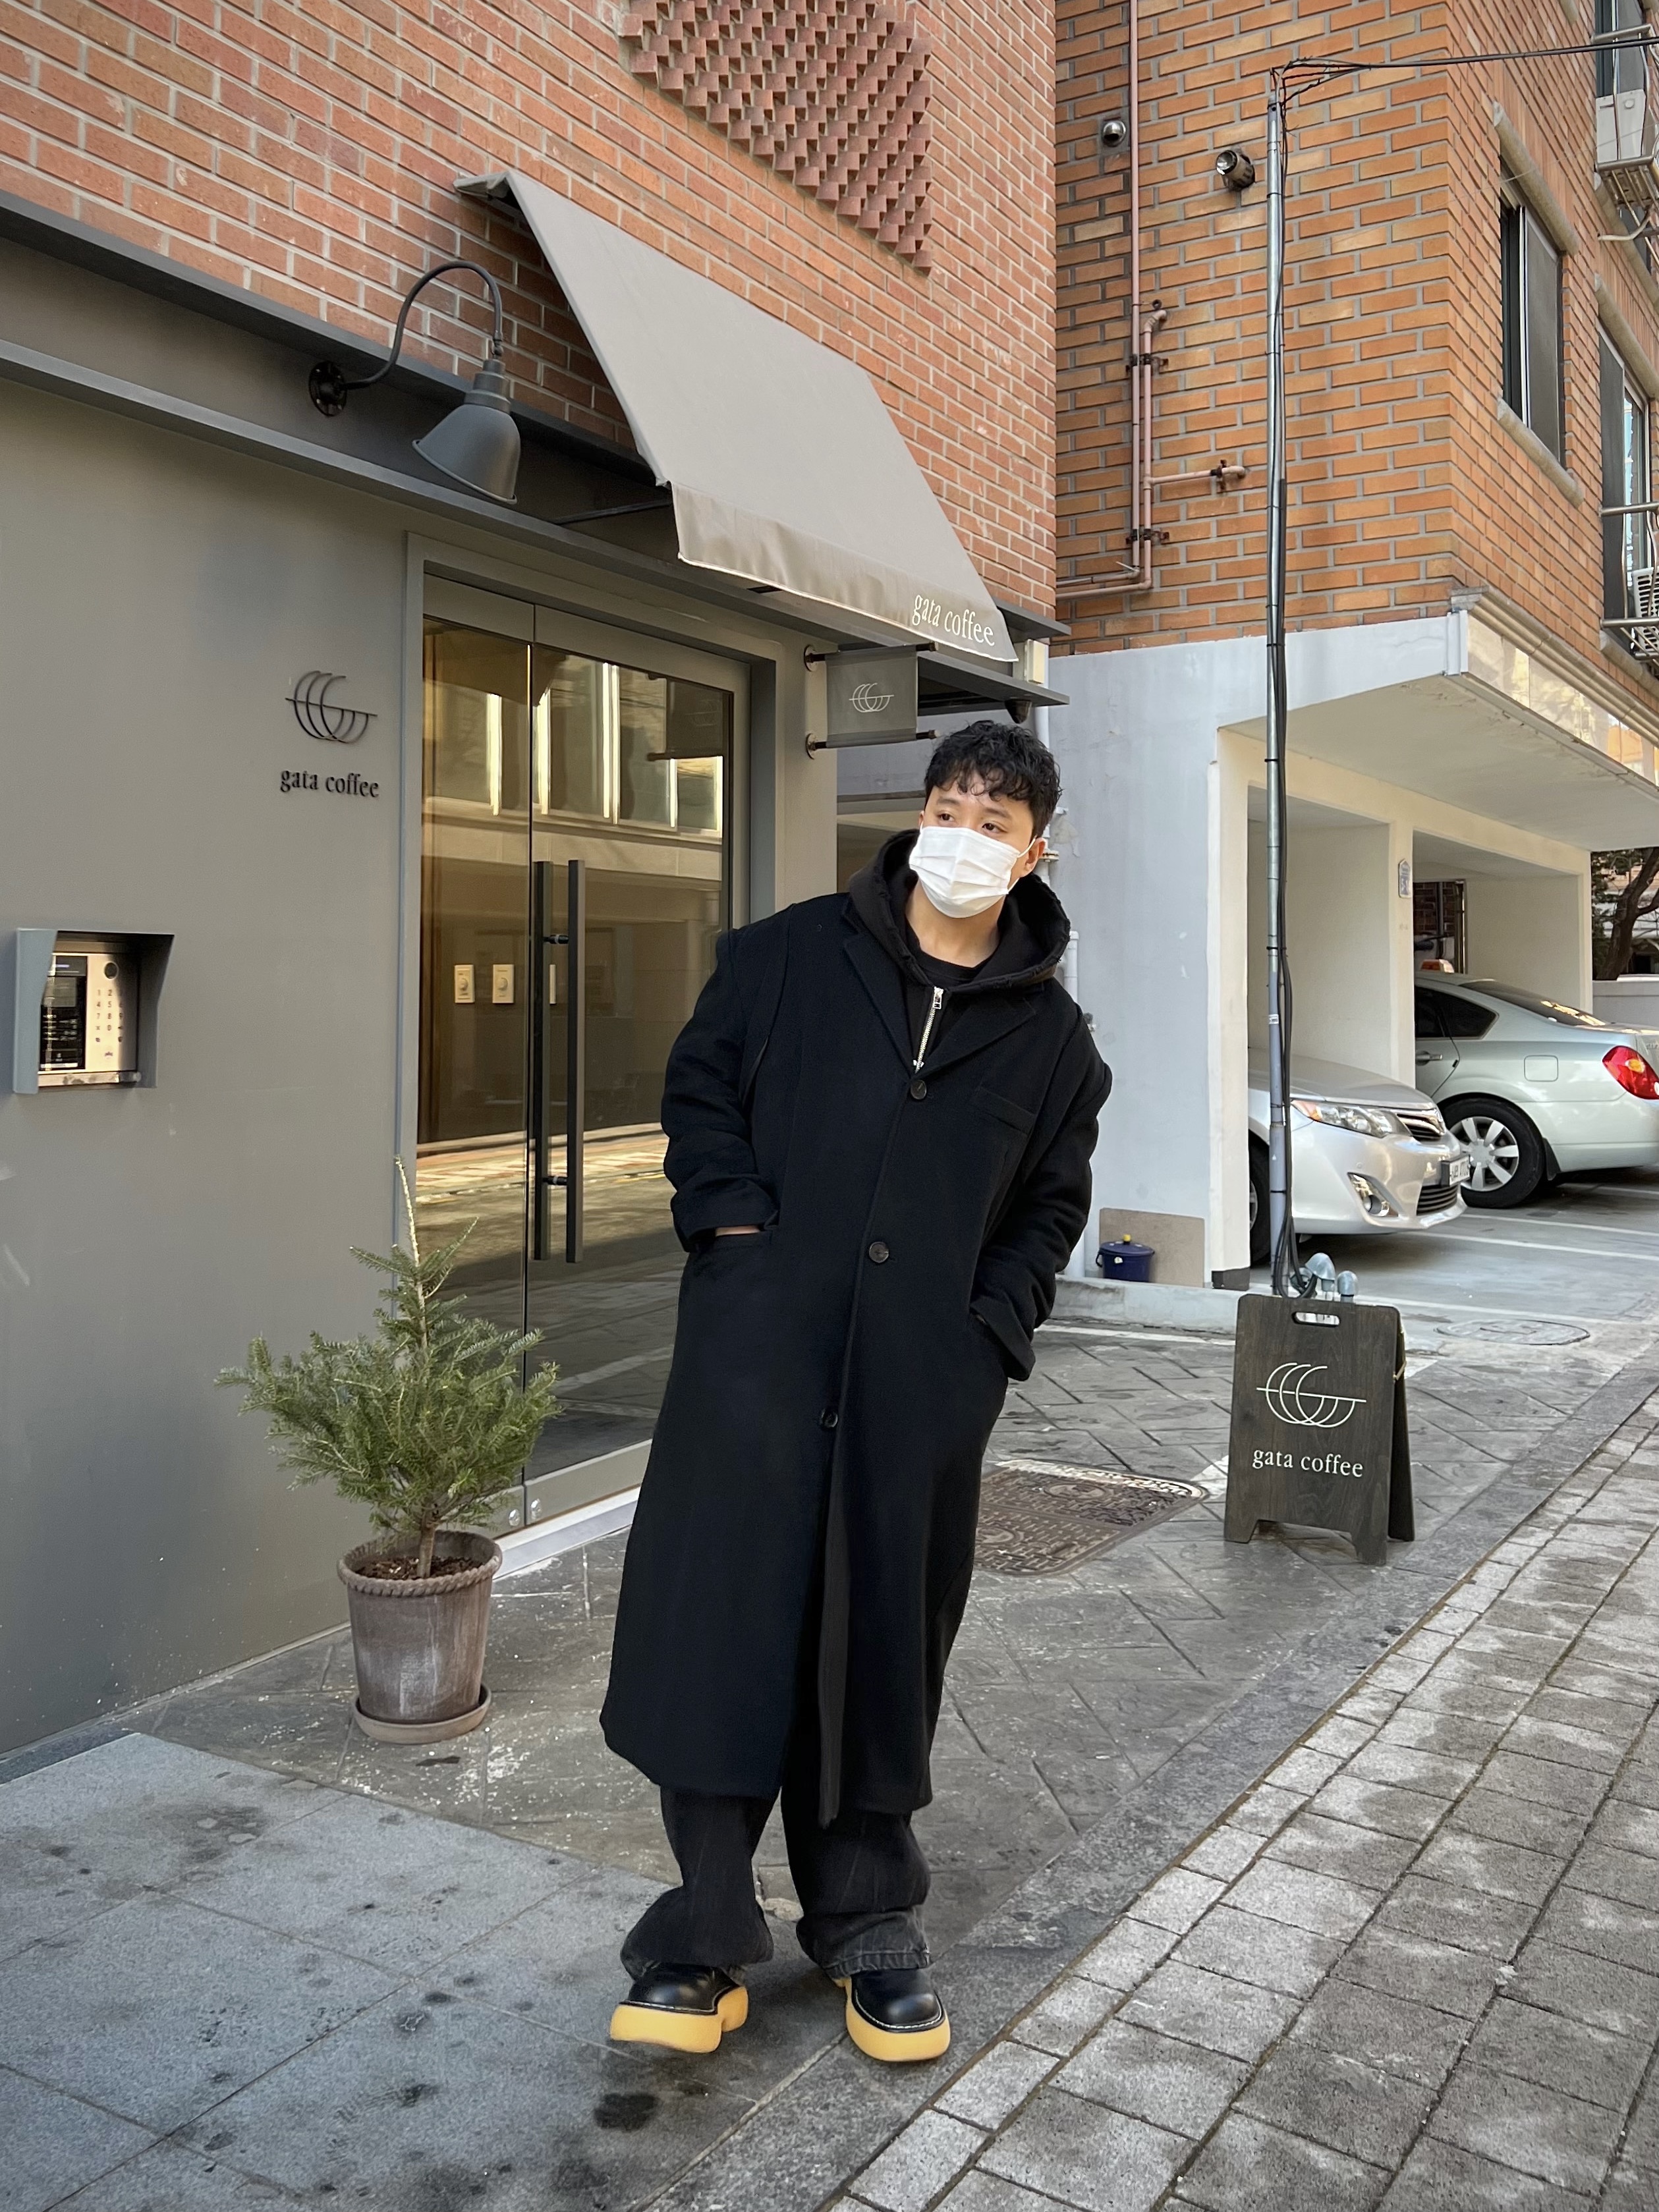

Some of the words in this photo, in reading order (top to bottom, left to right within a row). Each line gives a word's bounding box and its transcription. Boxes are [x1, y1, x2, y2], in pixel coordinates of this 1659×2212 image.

[912, 594, 942, 627] gata
[944, 609, 995, 646] coffee
[280, 770, 319, 792] gata
[325, 773, 380, 798] coffee
[1252, 1449, 1294, 1470] gata
[1301, 1453, 1363, 1478] coffee
